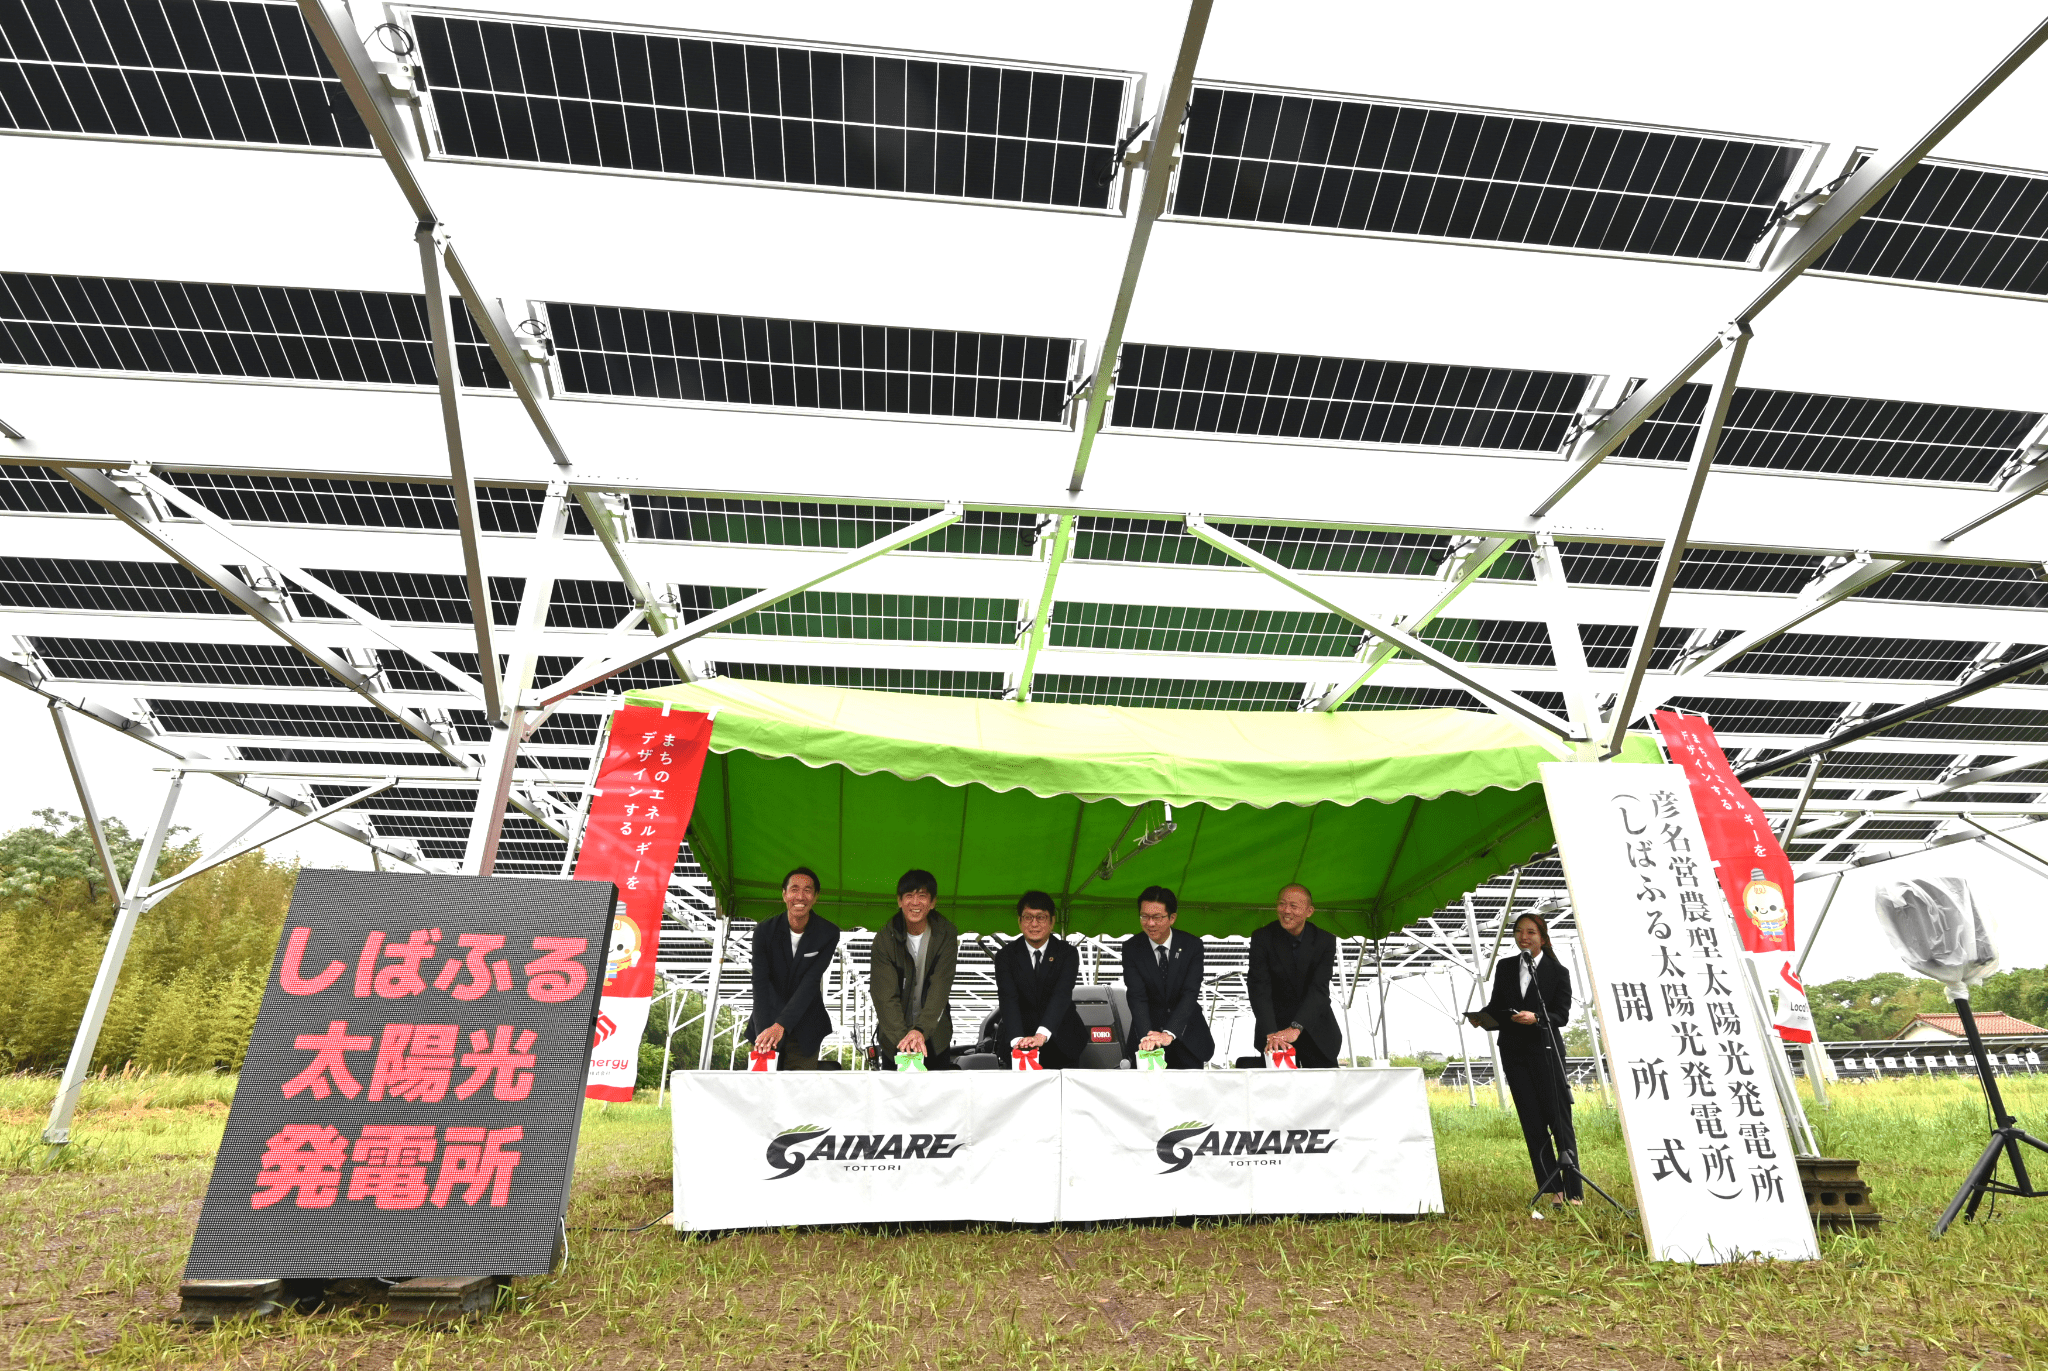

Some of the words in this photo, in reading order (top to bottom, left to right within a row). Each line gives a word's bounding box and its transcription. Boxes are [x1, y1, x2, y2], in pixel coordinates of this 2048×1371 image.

[620, 731, 658, 836] デザインする
[626, 734, 676, 890] まちのエネルギーを
[1681, 730, 1732, 810] デザインする
[1692, 733, 1767, 857] まちのエネルギーを
[279, 926, 589, 1003] しばふる
[1649, 790, 1785, 1204] 彦名営農型太陽光発電所
[281, 1020, 539, 1104] 太陽光
[590, 1059, 629, 1070] nergy
[1611, 982, 1692, 1184] 開所式
[250, 1124, 525, 1211] 発電所
[762, 1125, 966, 1180] GAINARE
[1154, 1122, 1339, 1175] GAINARE
[1229, 1159, 1282, 1167] TOTTORI
